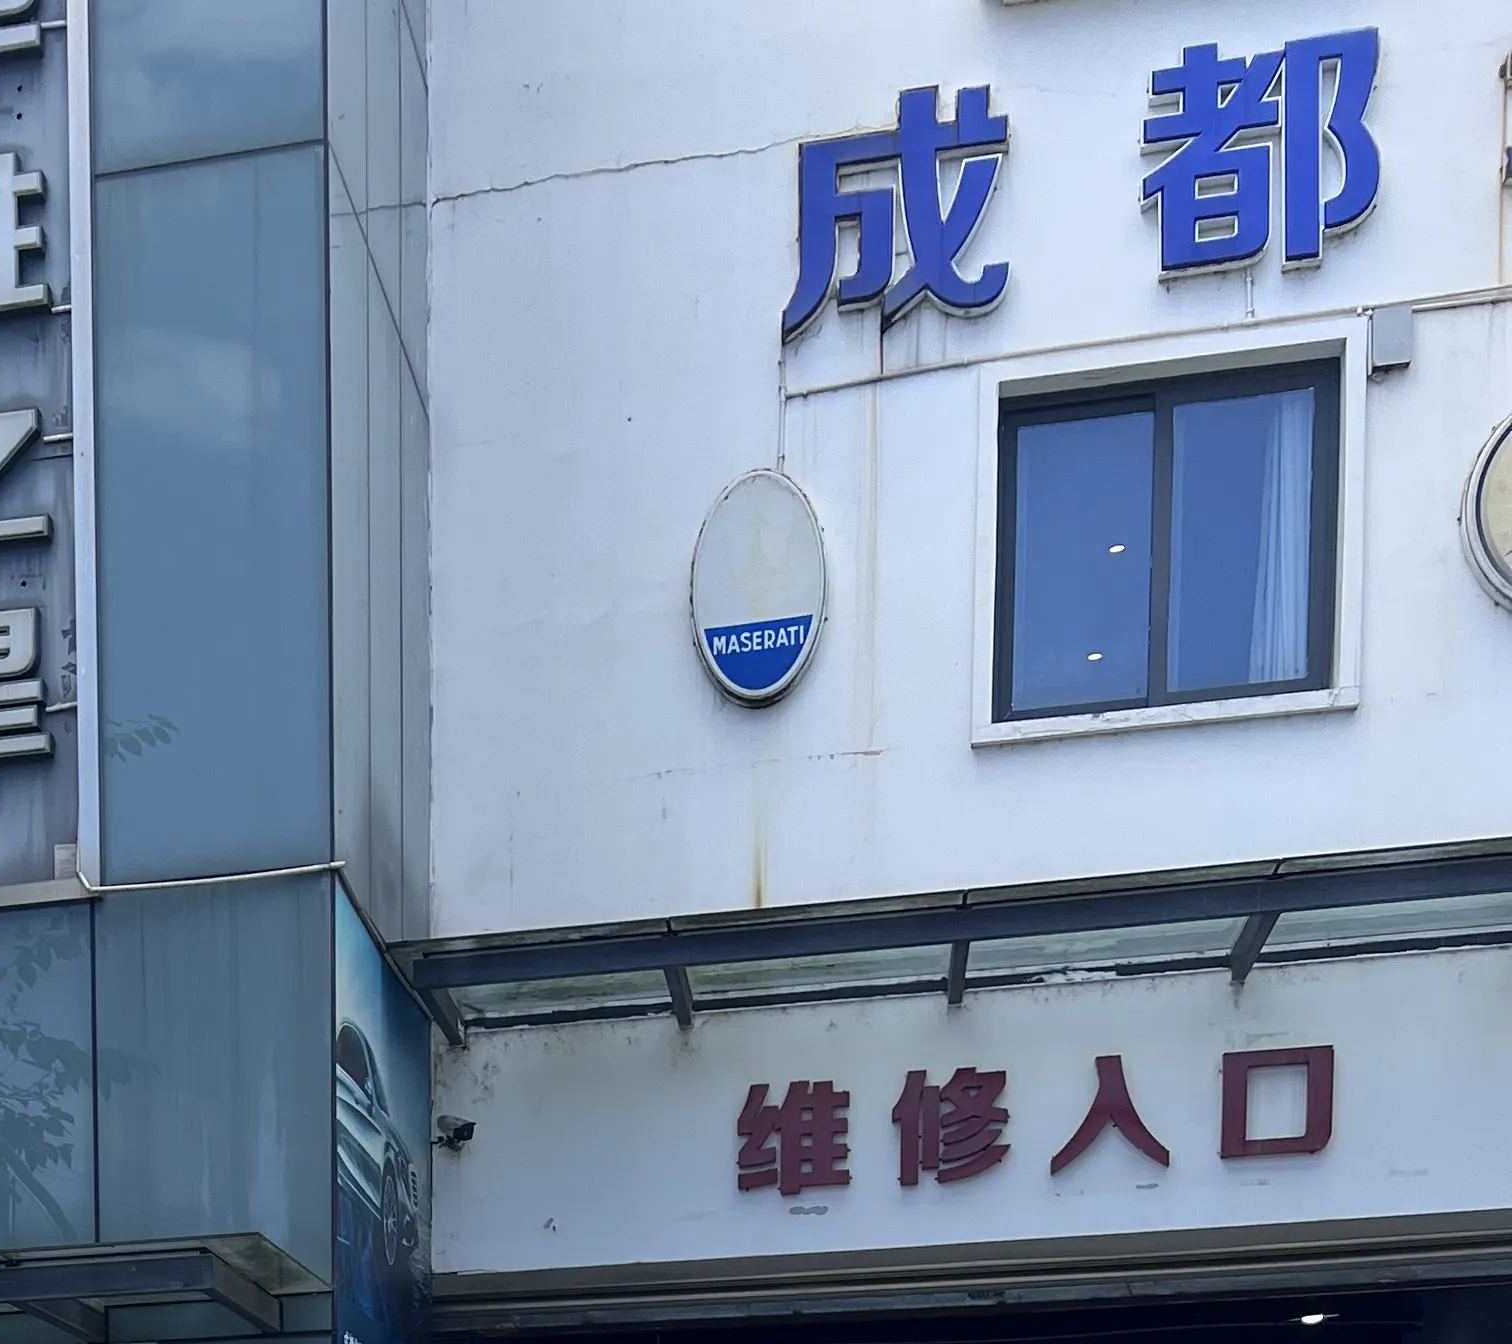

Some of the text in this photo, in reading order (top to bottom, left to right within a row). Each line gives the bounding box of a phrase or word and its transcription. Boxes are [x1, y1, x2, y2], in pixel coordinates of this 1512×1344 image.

[781, 27, 1384, 345] 成都
[712, 624, 806, 656] MASERATI
[737, 1044, 1335, 1196] 维修入口
